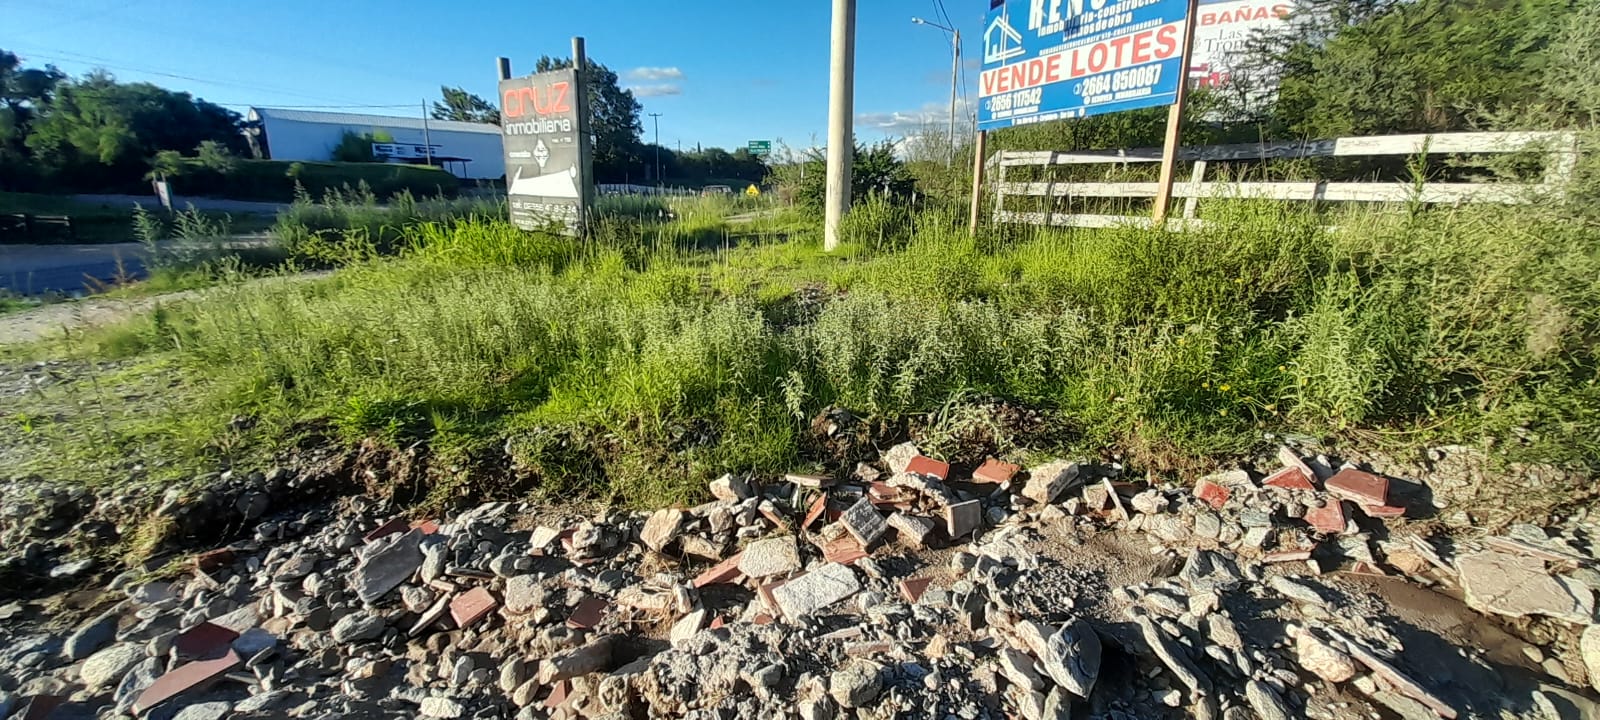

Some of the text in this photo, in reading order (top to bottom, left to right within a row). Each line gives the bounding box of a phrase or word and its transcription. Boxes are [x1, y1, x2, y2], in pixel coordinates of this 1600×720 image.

[1197, 4, 1290, 26] BAÑAS
[1204, 38, 1246, 52] Tron
[1219, 29, 1242, 40] Las
[983, 54, 1061, 95] VENDE
[1070, 24, 1177, 77] LOTES
[1081, 64, 1162, 97] 2664 850087
[503, 81, 570, 118] cruz
[990, 94, 1012, 112] 2656
[1013, 87, 1043, 108] 117542
[506, 116, 571, 136] inmobiliaria
